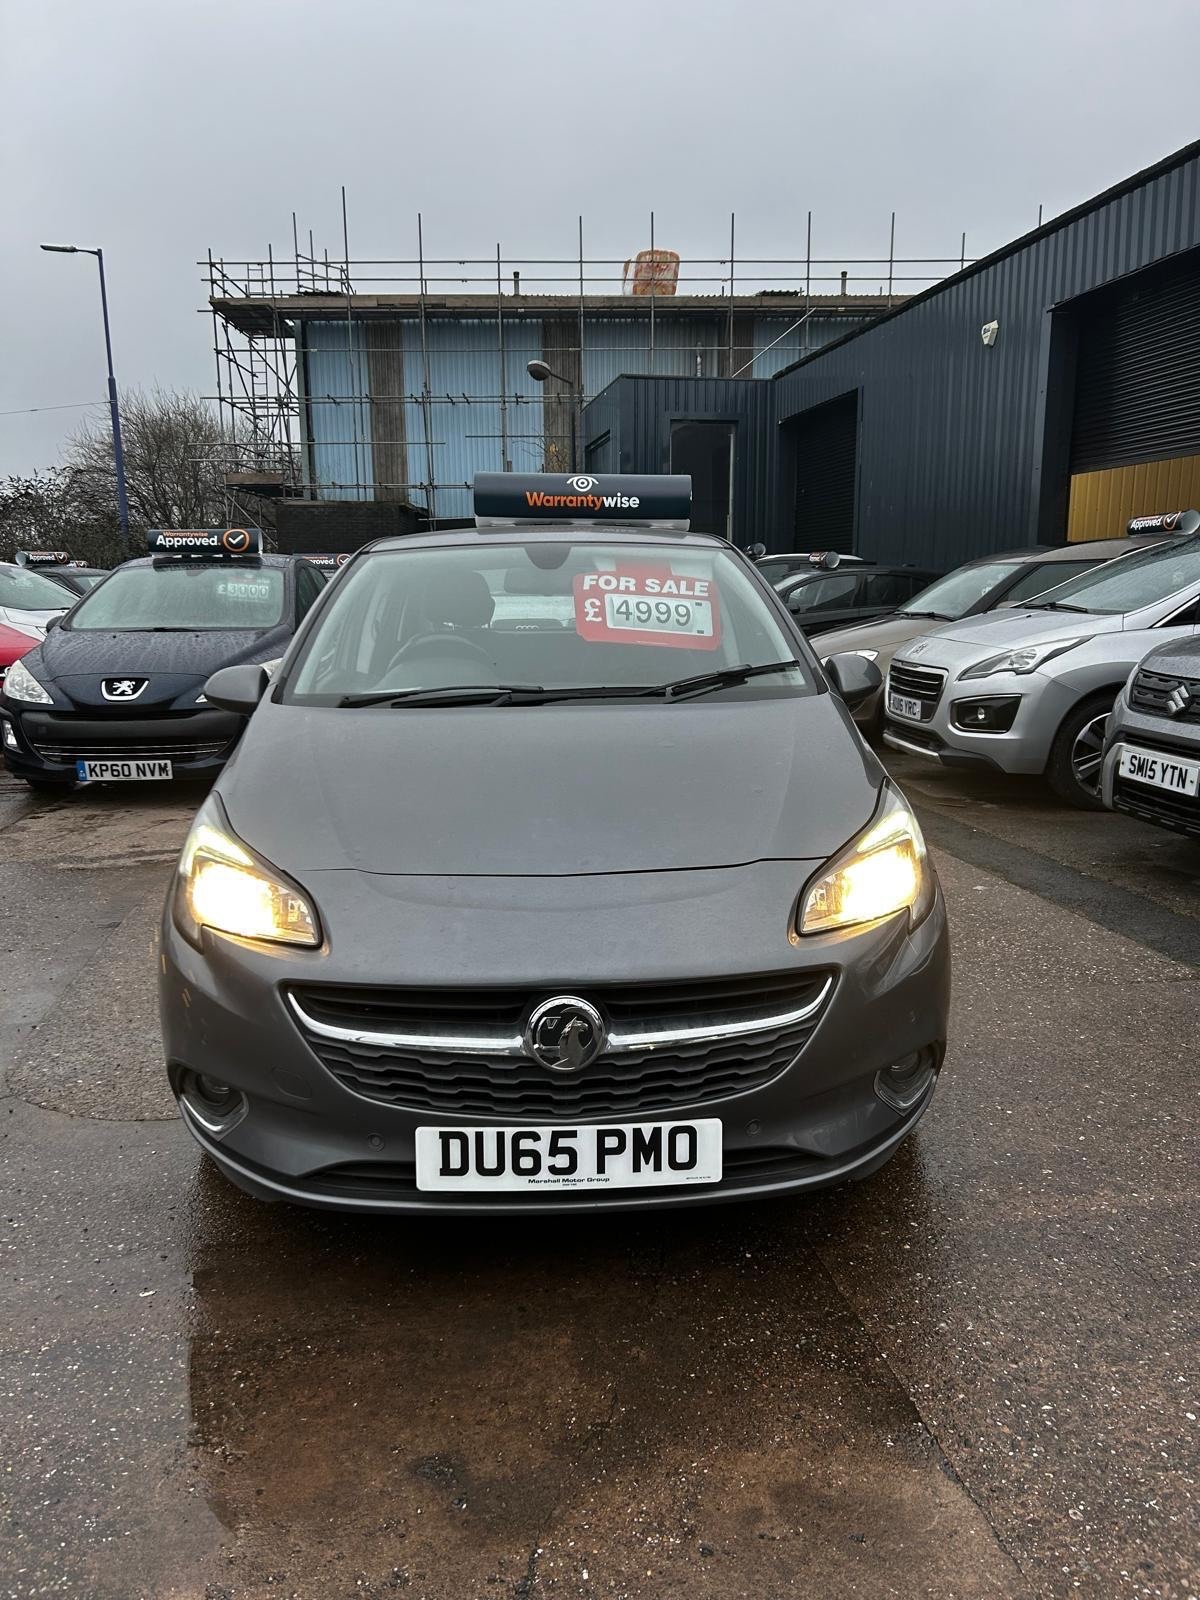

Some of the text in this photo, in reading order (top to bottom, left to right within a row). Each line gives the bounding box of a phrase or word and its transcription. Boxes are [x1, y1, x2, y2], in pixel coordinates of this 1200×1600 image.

[525, 491, 640, 510] Warrantywise
[583, 575, 709, 597] FOR SALE
[584, 598, 691, 627] £ 4999
[88, 763, 132, 777] KP60
[135, 762, 170, 777] NVM
[1128, 754, 1188, 789] SM15 YTN
[438, 1125, 698, 1177] DU65 PMO
